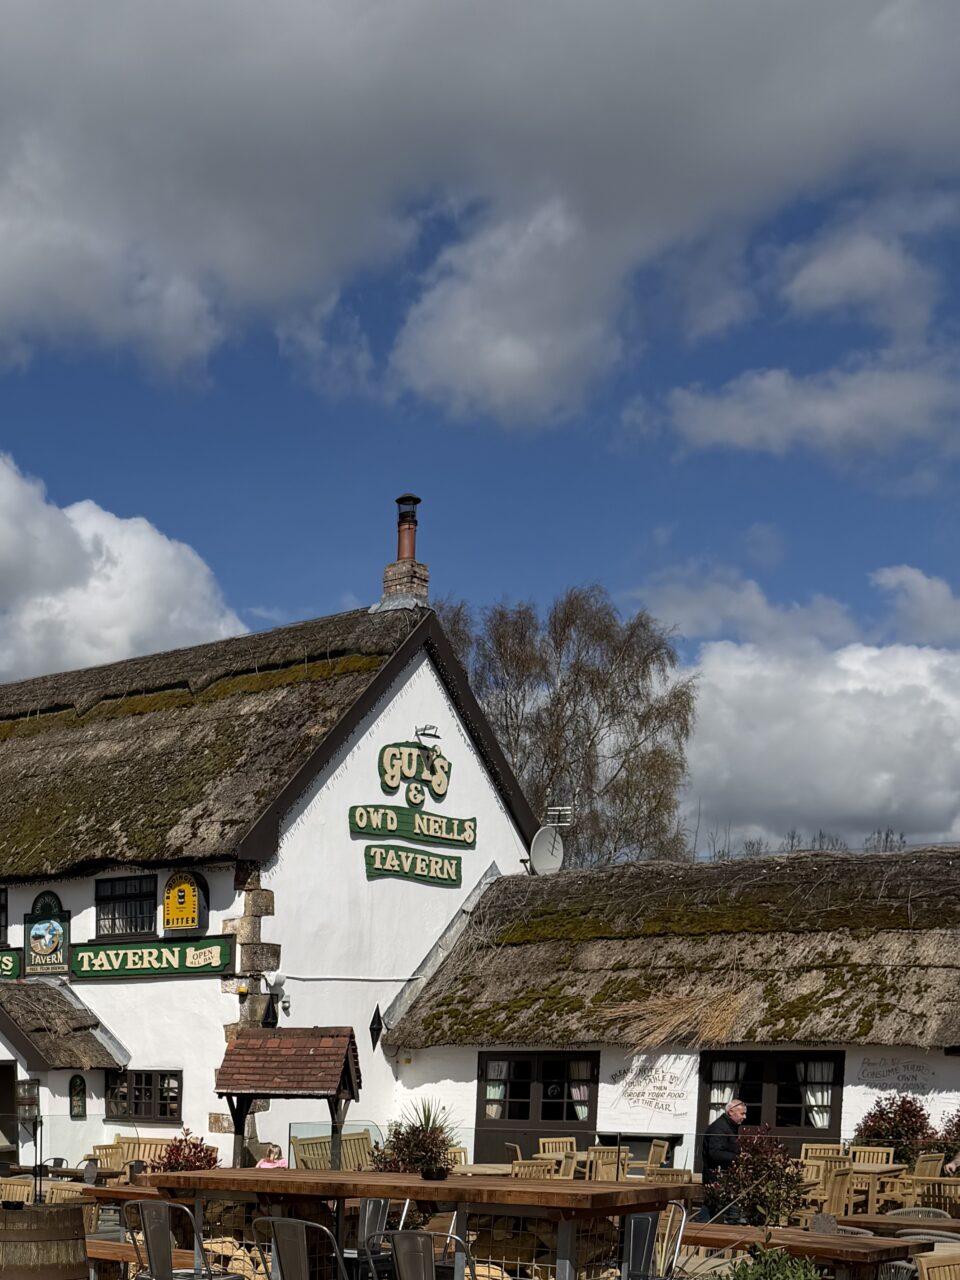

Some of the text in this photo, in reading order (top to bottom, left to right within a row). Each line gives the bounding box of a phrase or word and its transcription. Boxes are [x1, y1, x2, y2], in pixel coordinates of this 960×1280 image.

[408, 783, 425, 804] &
[355, 806, 475, 843] OWD NELLS
[370, 848, 457, 880] TAVERN
[166, 916, 196, 926] BITTER
[30, 949, 63, 965] TAVERN
[78, 947, 181, 972] TAVERN
[192, 948, 213, 961] OPEN
[203, 955, 215, 963] DAY
[641, 1099, 653, 1107] THE
[653, 1102, 672, 1112] BAR
